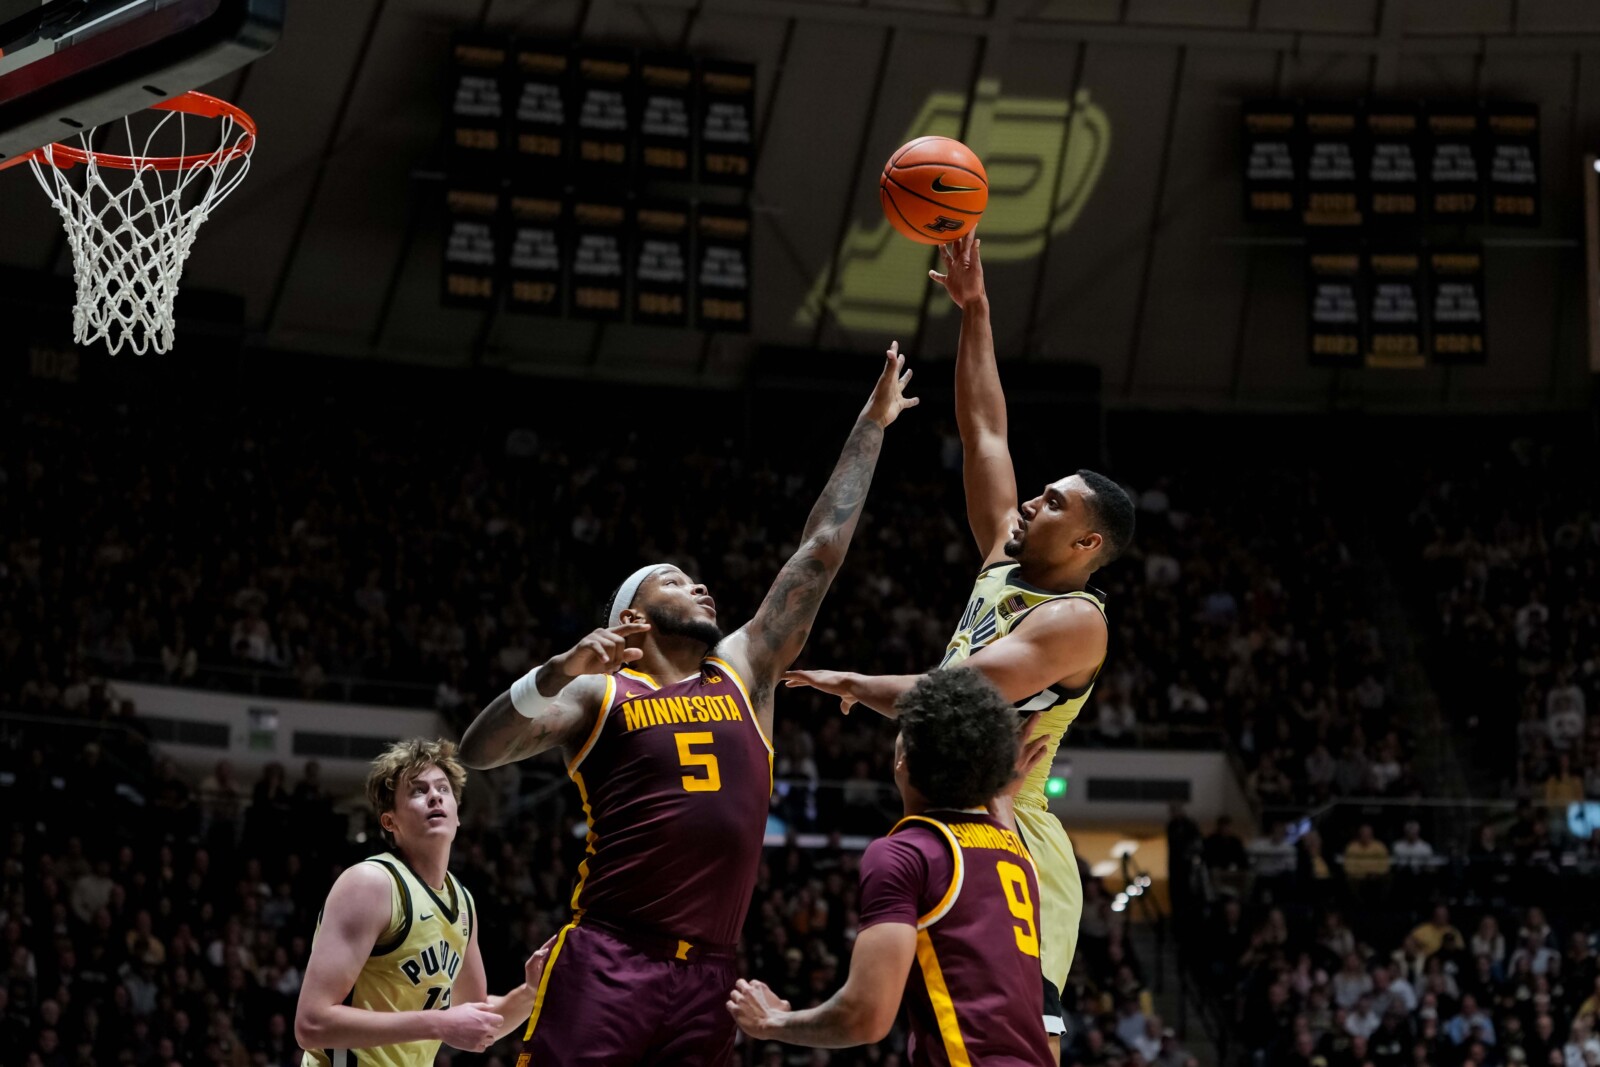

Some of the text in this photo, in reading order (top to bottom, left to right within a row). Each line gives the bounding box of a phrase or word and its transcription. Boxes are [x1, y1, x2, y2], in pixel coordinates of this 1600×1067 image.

[622, 694, 743, 732] MINNESOTA
[674, 731, 722, 792] 5
[996, 861, 1039, 959] 9
